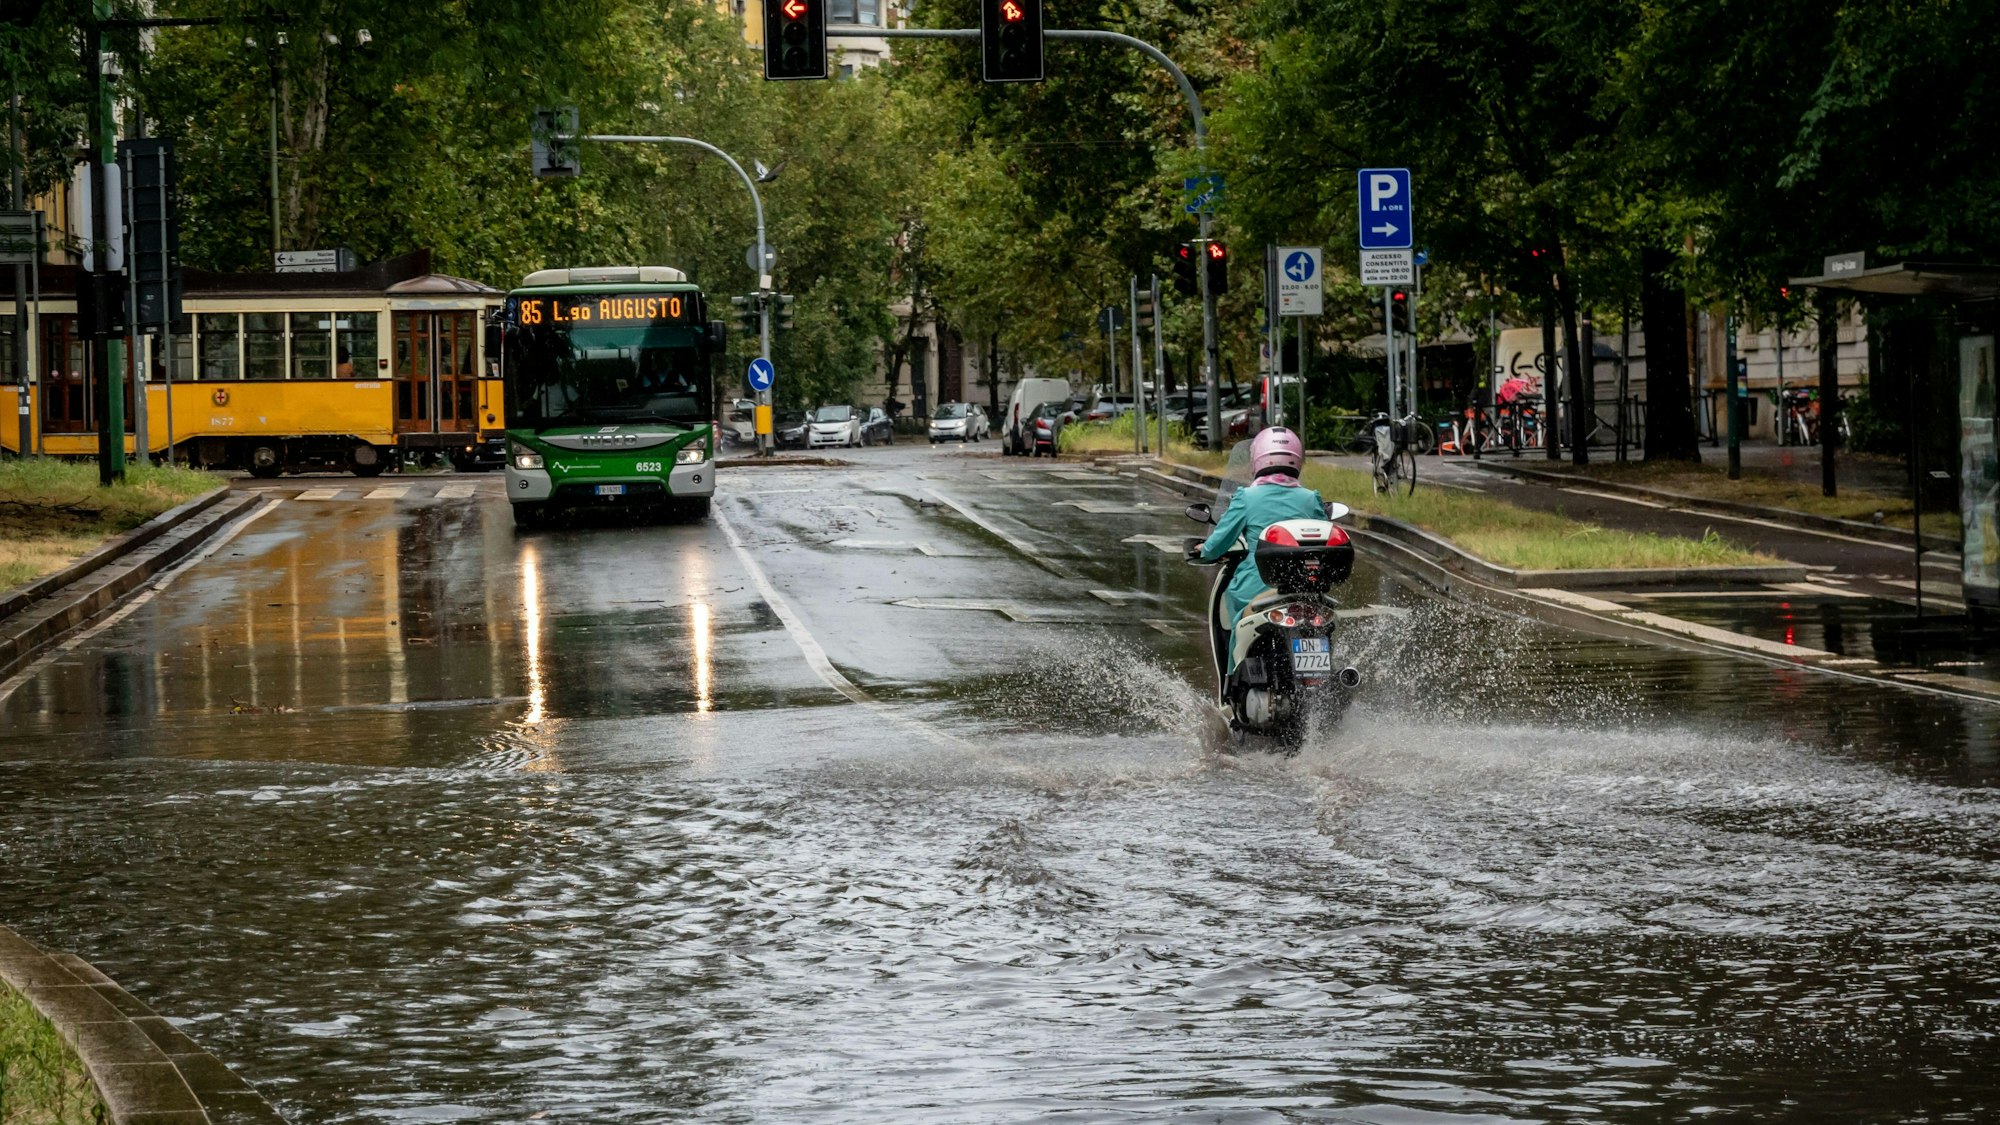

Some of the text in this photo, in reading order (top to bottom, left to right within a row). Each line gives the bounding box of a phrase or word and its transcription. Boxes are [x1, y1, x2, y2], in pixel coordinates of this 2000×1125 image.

[1370, 174, 1399, 211] P
[521, 298, 681, 324] 85 L.go AUGUSTO
[211, 417, 234, 426] 1877
[582, 434, 637, 446] IVECO
[636, 462, 662, 472] 6523
[1301, 640, 1315, 651] DN
[1296, 655, 1329, 668] 77724
